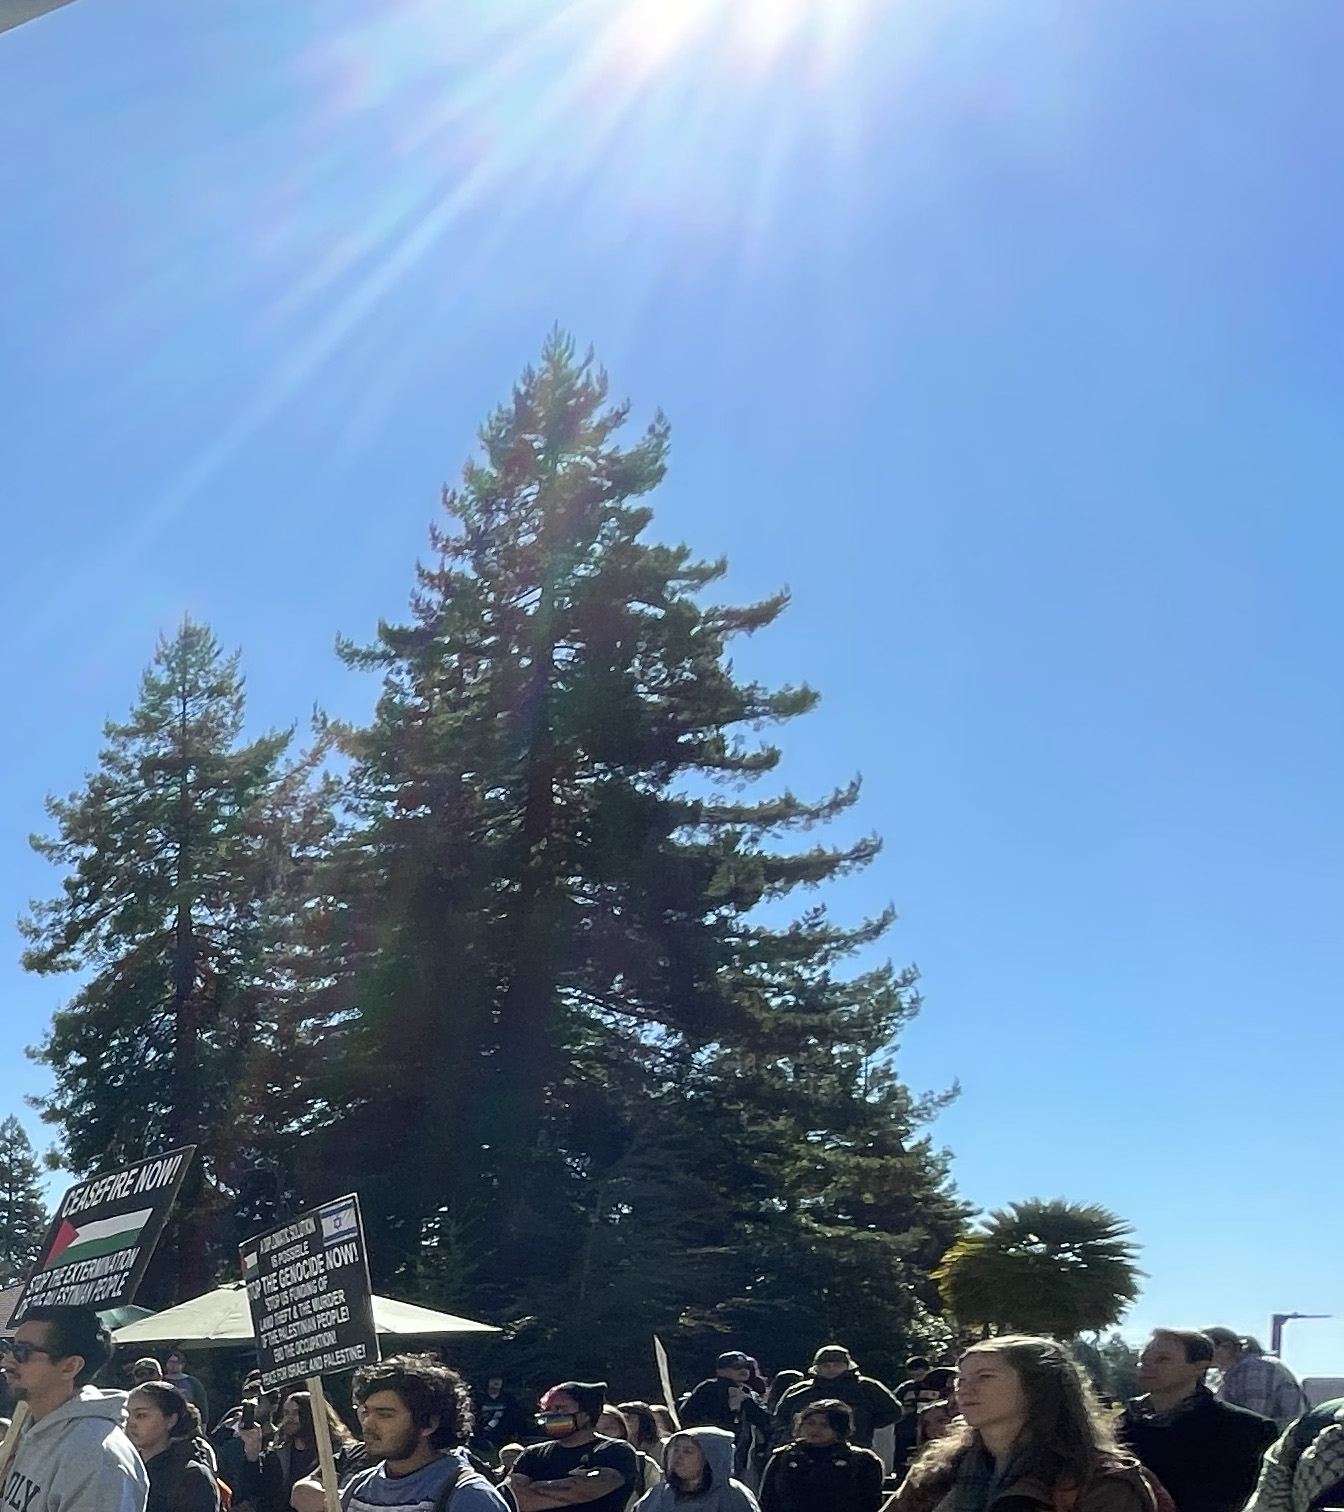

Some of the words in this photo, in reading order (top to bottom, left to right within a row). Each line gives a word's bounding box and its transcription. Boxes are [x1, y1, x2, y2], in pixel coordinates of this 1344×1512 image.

[62, 1167, 139, 1218] CEASEFIRE
[133, 1154, 183, 1195] NOW!
[26, 1270, 52, 1296] STOP
[47, 1266, 69, 1289] THE
[63, 1246, 141, 1284] EXTERMINATION
[90, 1271, 130, 1302] PEOPLE
[261, 1272, 279, 1295] THE
[278, 1253, 325, 1289] GENOCIDE
[325, 1241, 359, 1271] NOW!
[318, 1274, 328, 1292] OF
